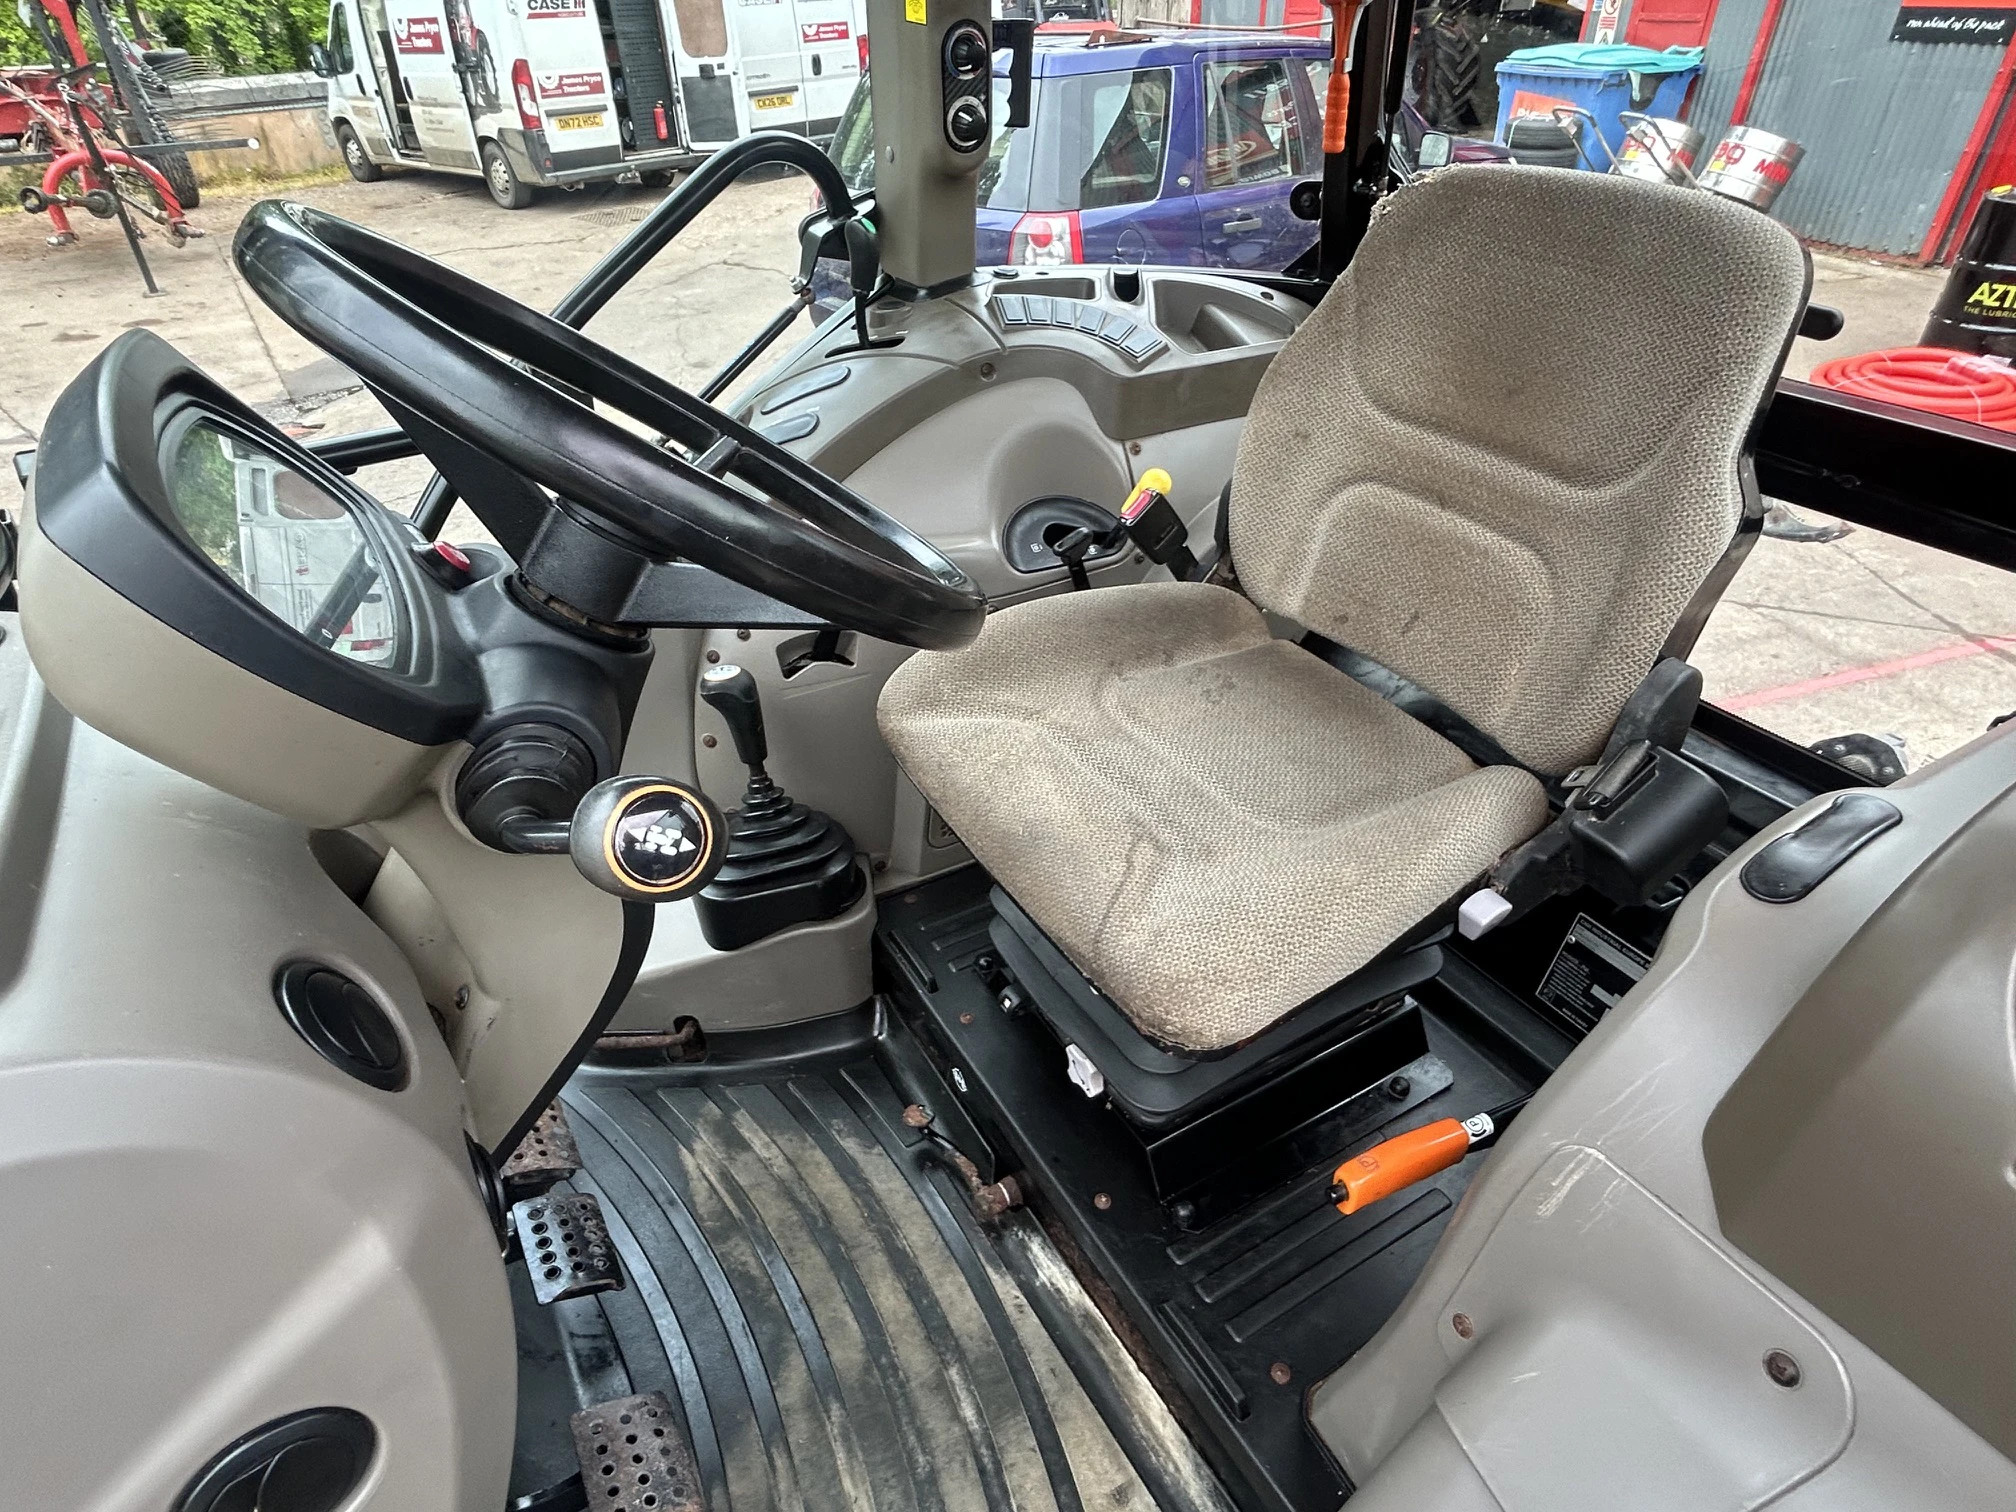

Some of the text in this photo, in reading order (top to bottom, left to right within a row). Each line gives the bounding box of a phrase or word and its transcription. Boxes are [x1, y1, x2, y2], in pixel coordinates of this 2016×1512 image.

[1923, 16, 1955, 29] ahead
[1974, 19, 2006, 34] pack
[561, 75, 602, 85] James Pryce
[562, 84, 591, 93] Tractors
[583, 115, 600, 127] HSC
[1967, 281, 2016, 307] AZT
[1963, 305, 1980, 314] THE
